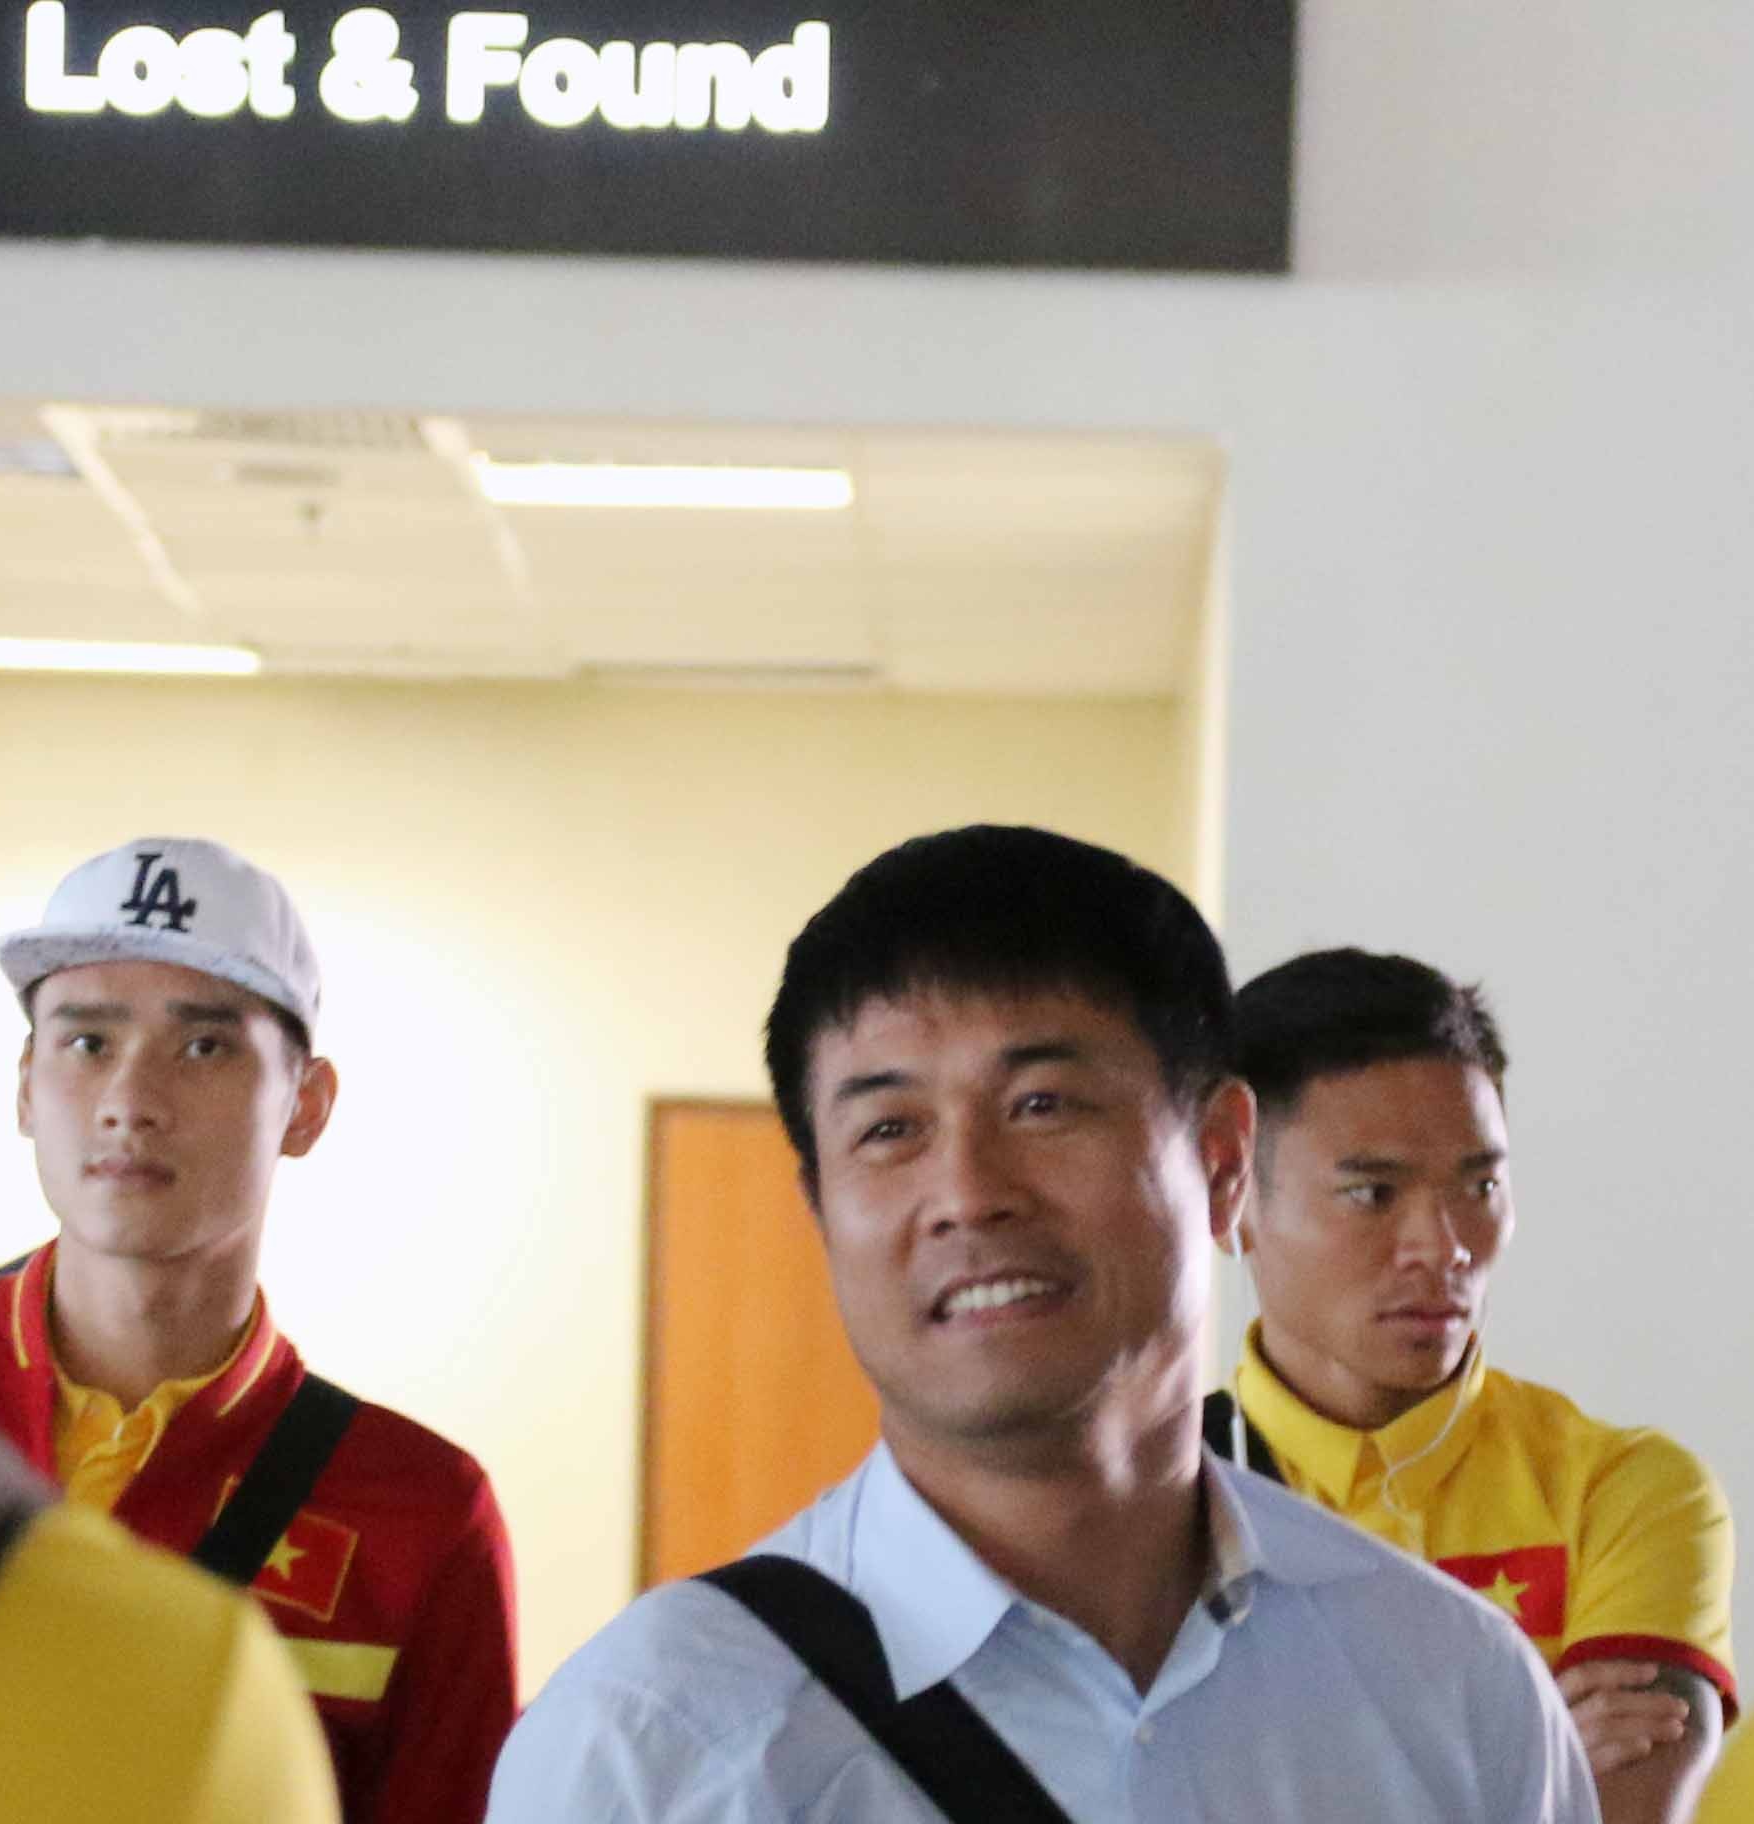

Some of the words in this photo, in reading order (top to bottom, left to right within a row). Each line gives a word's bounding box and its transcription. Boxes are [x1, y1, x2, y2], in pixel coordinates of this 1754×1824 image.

[25, 0, 297, 117] Lost
[319, 7, 420, 122] &
[445, 11, 832, 133] Found
[120, 852, 197, 933] LA
